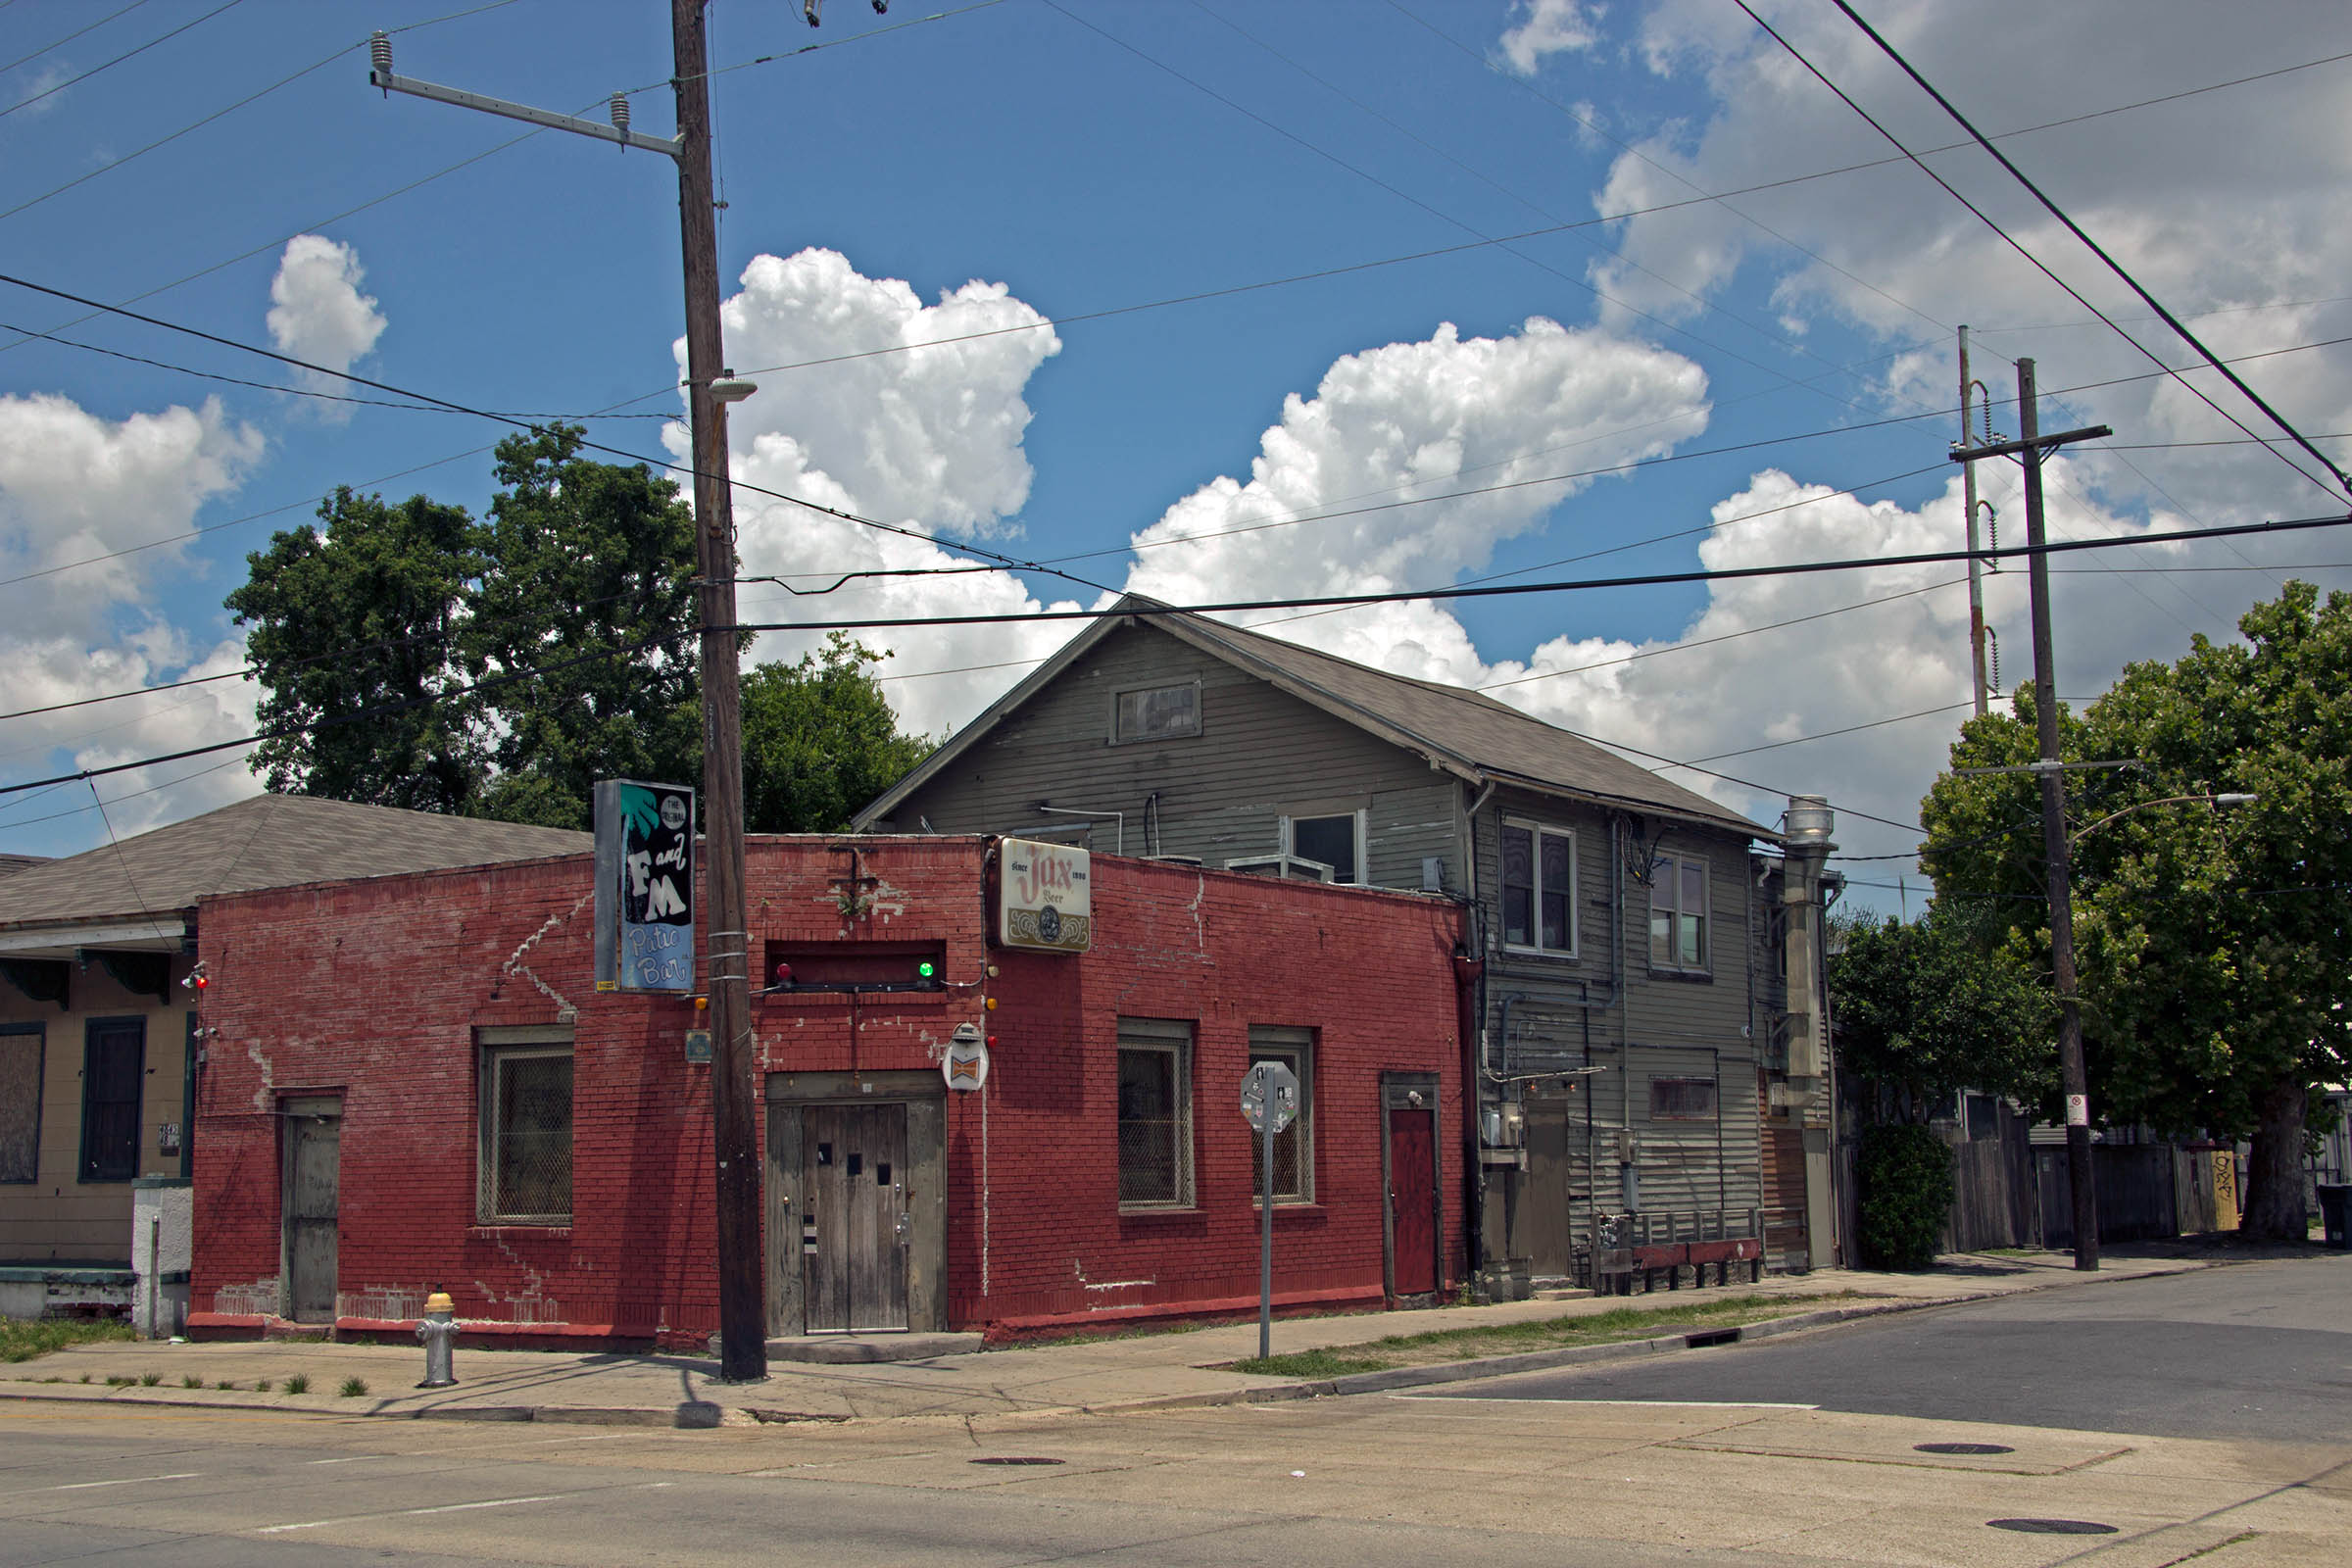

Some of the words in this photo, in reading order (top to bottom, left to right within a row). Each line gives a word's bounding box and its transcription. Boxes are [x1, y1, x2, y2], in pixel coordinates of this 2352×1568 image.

[666, 800, 680, 809] THE
[627, 850, 652, 897] F
[656, 833, 686, 870] and
[1015, 846, 1073, 905] Jax
[645, 875, 686, 921] M
[1043, 889, 1064, 904] Beer
[638, 957, 686, 984] Bar
